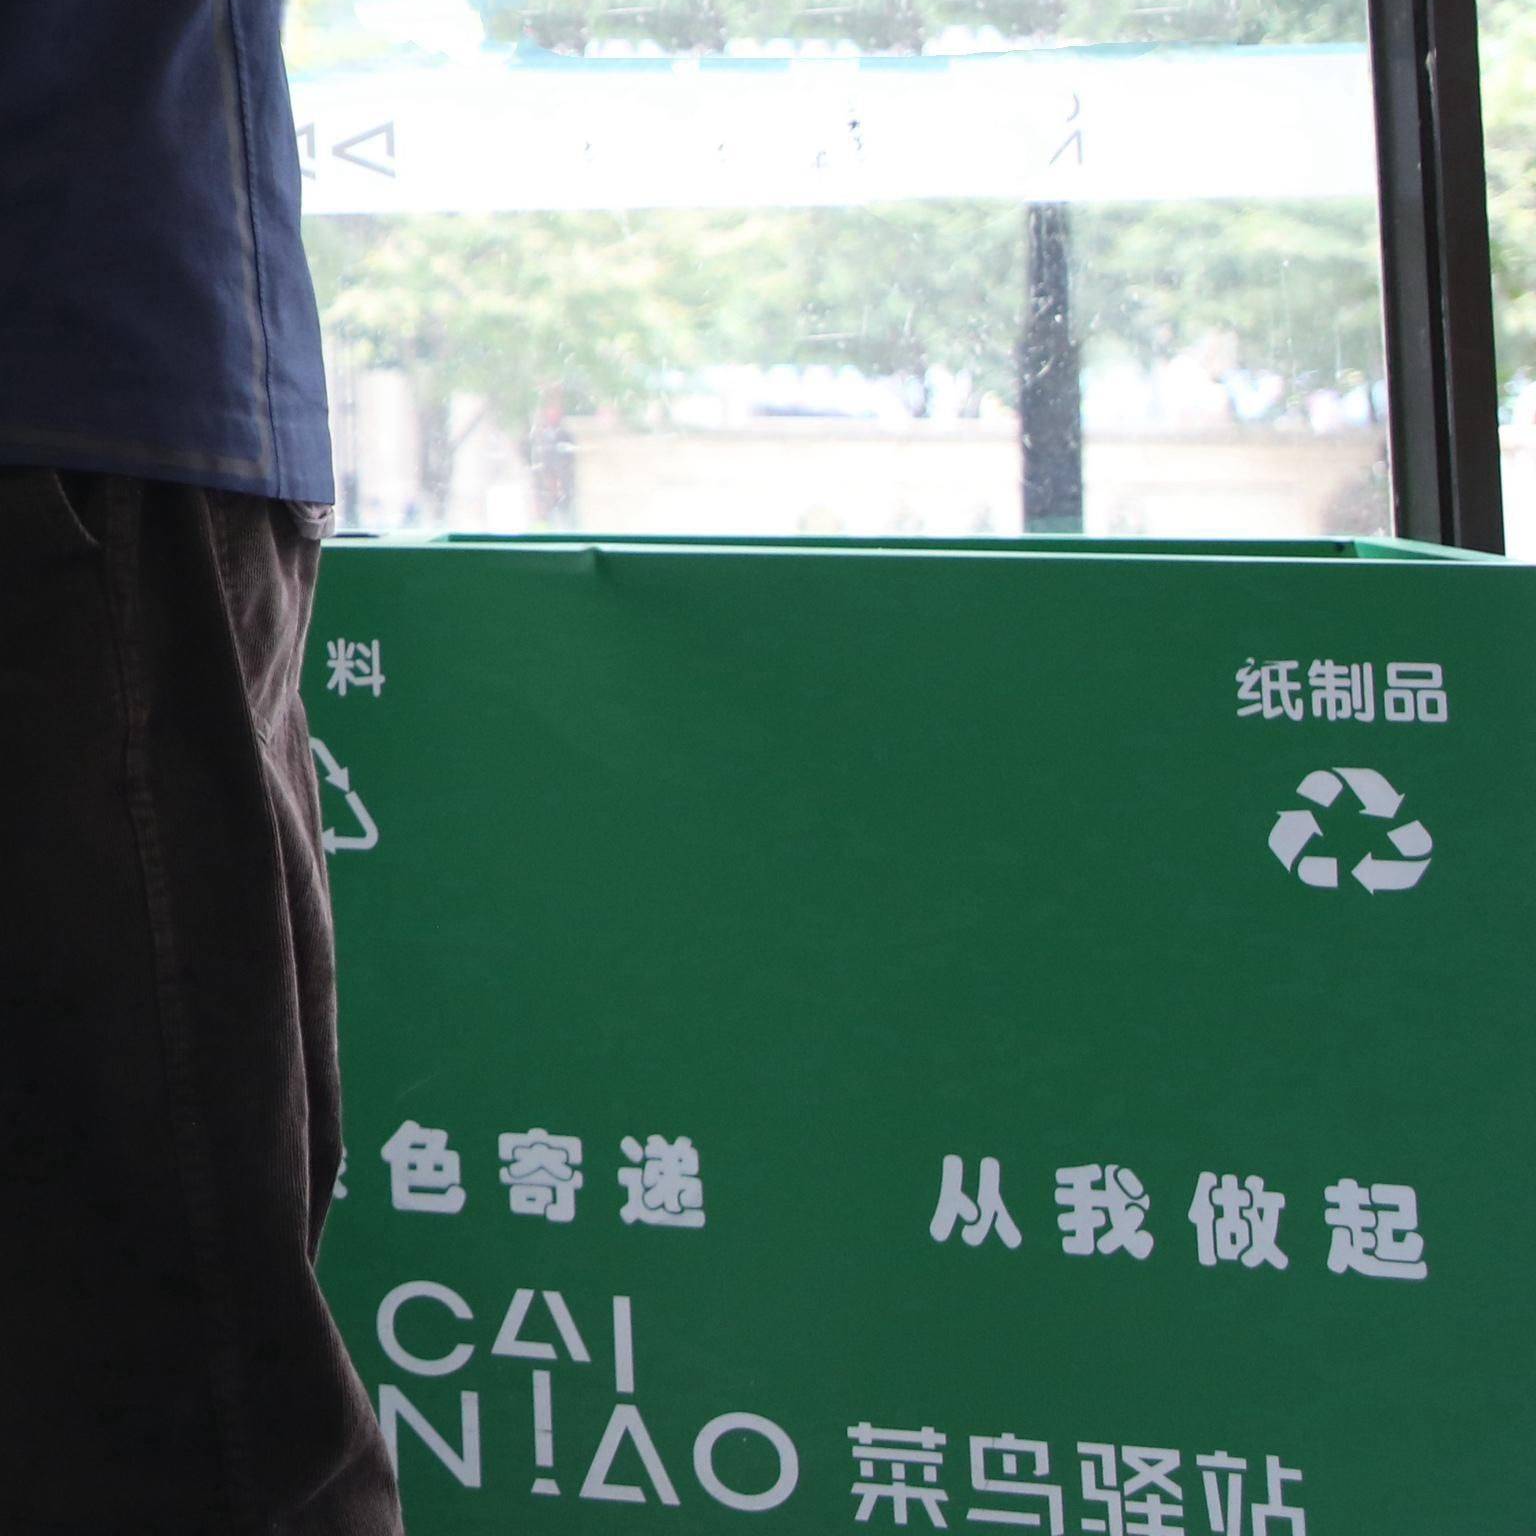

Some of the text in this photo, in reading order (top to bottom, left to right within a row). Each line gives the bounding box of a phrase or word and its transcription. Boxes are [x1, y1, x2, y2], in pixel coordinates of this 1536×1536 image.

[326, 637, 386, 697] 料
[1235, 657, 1449, 723] 纸制品
[335, 1119, 1428, 1281] 色寄递 从我做起
[375, 1280, 635, 1393] CAI
[846, 1421, 1307, 1536] 菜鸟驿站
